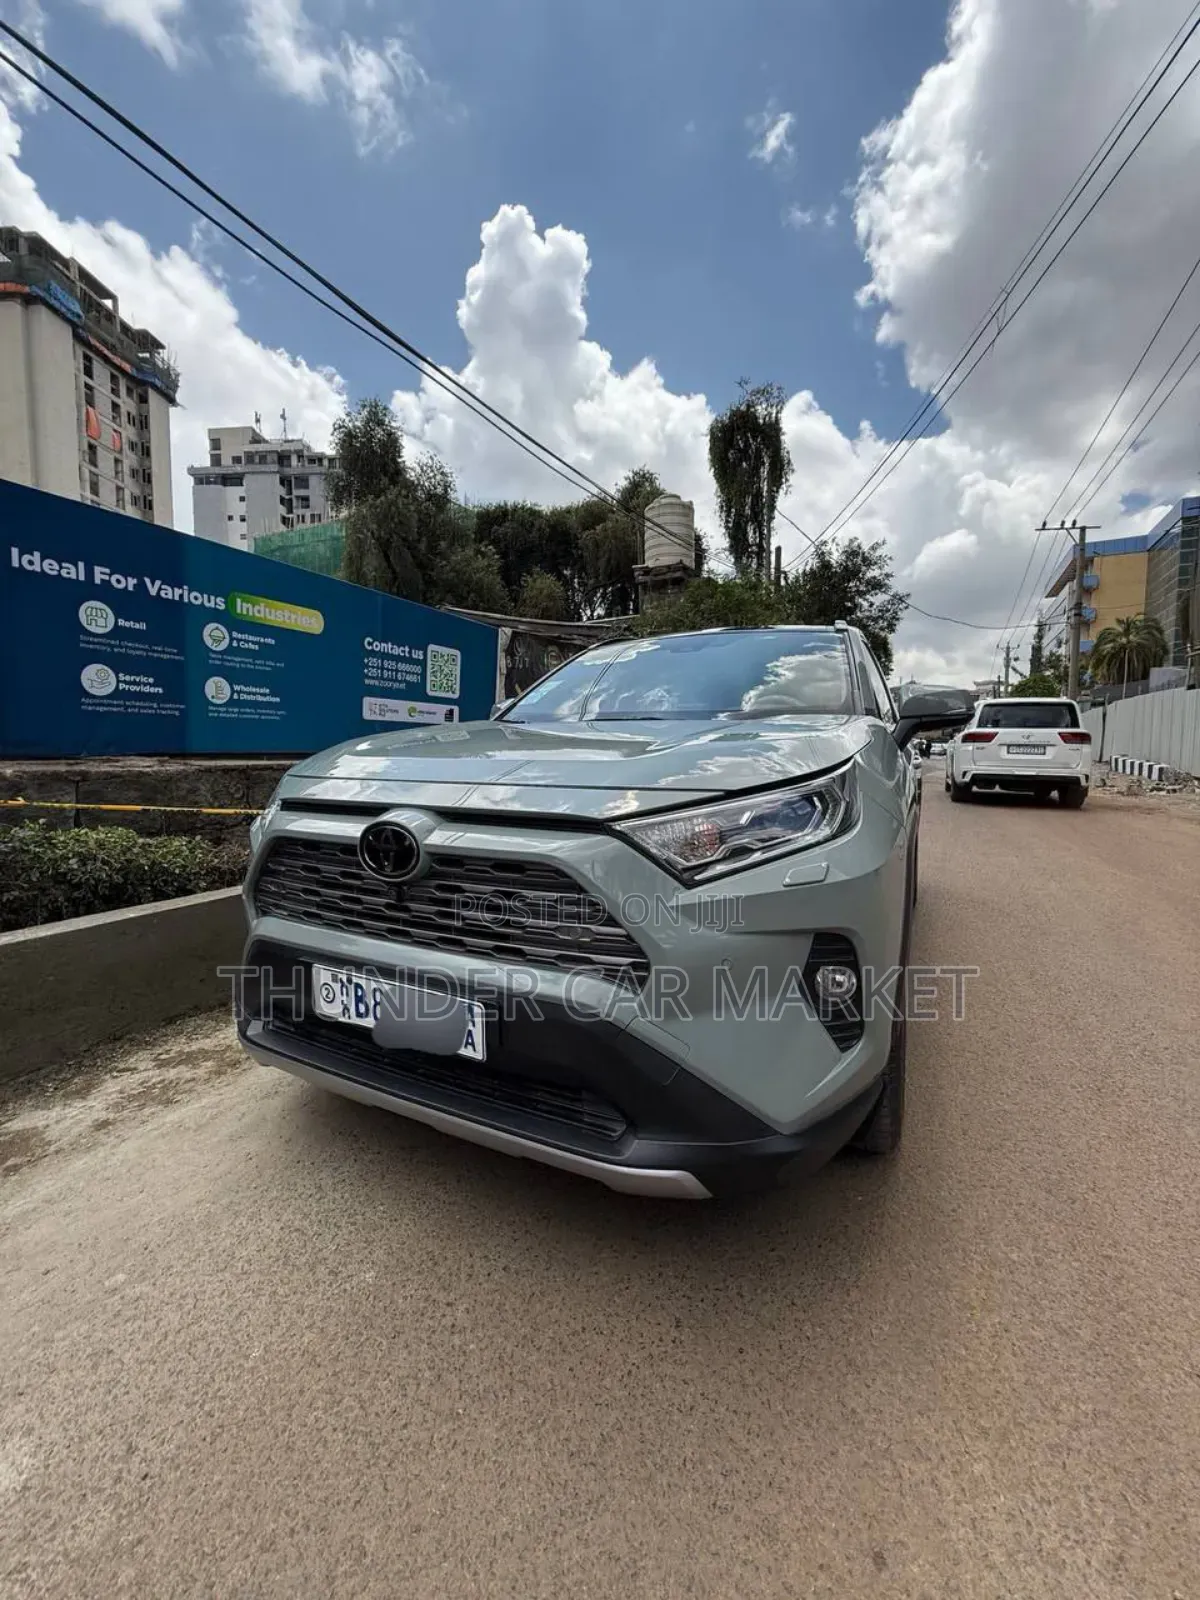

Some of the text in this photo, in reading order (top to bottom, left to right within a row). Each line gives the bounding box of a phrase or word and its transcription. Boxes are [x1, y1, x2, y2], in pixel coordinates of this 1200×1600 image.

[10, 546, 319, 627] Ideal For Various Industries
[117, 618, 147, 630] Retail
[364, 636, 424, 660] Contact us
[363, 656, 382, 668] +251
[118, 673, 154, 684] Service
[363, 668, 382, 679] +251
[383, 670, 396, 680] 911
[118, 683, 164, 694] Providers
[233, 684, 270, 694] Wholesale
[239, 694, 281, 703] Distribution
